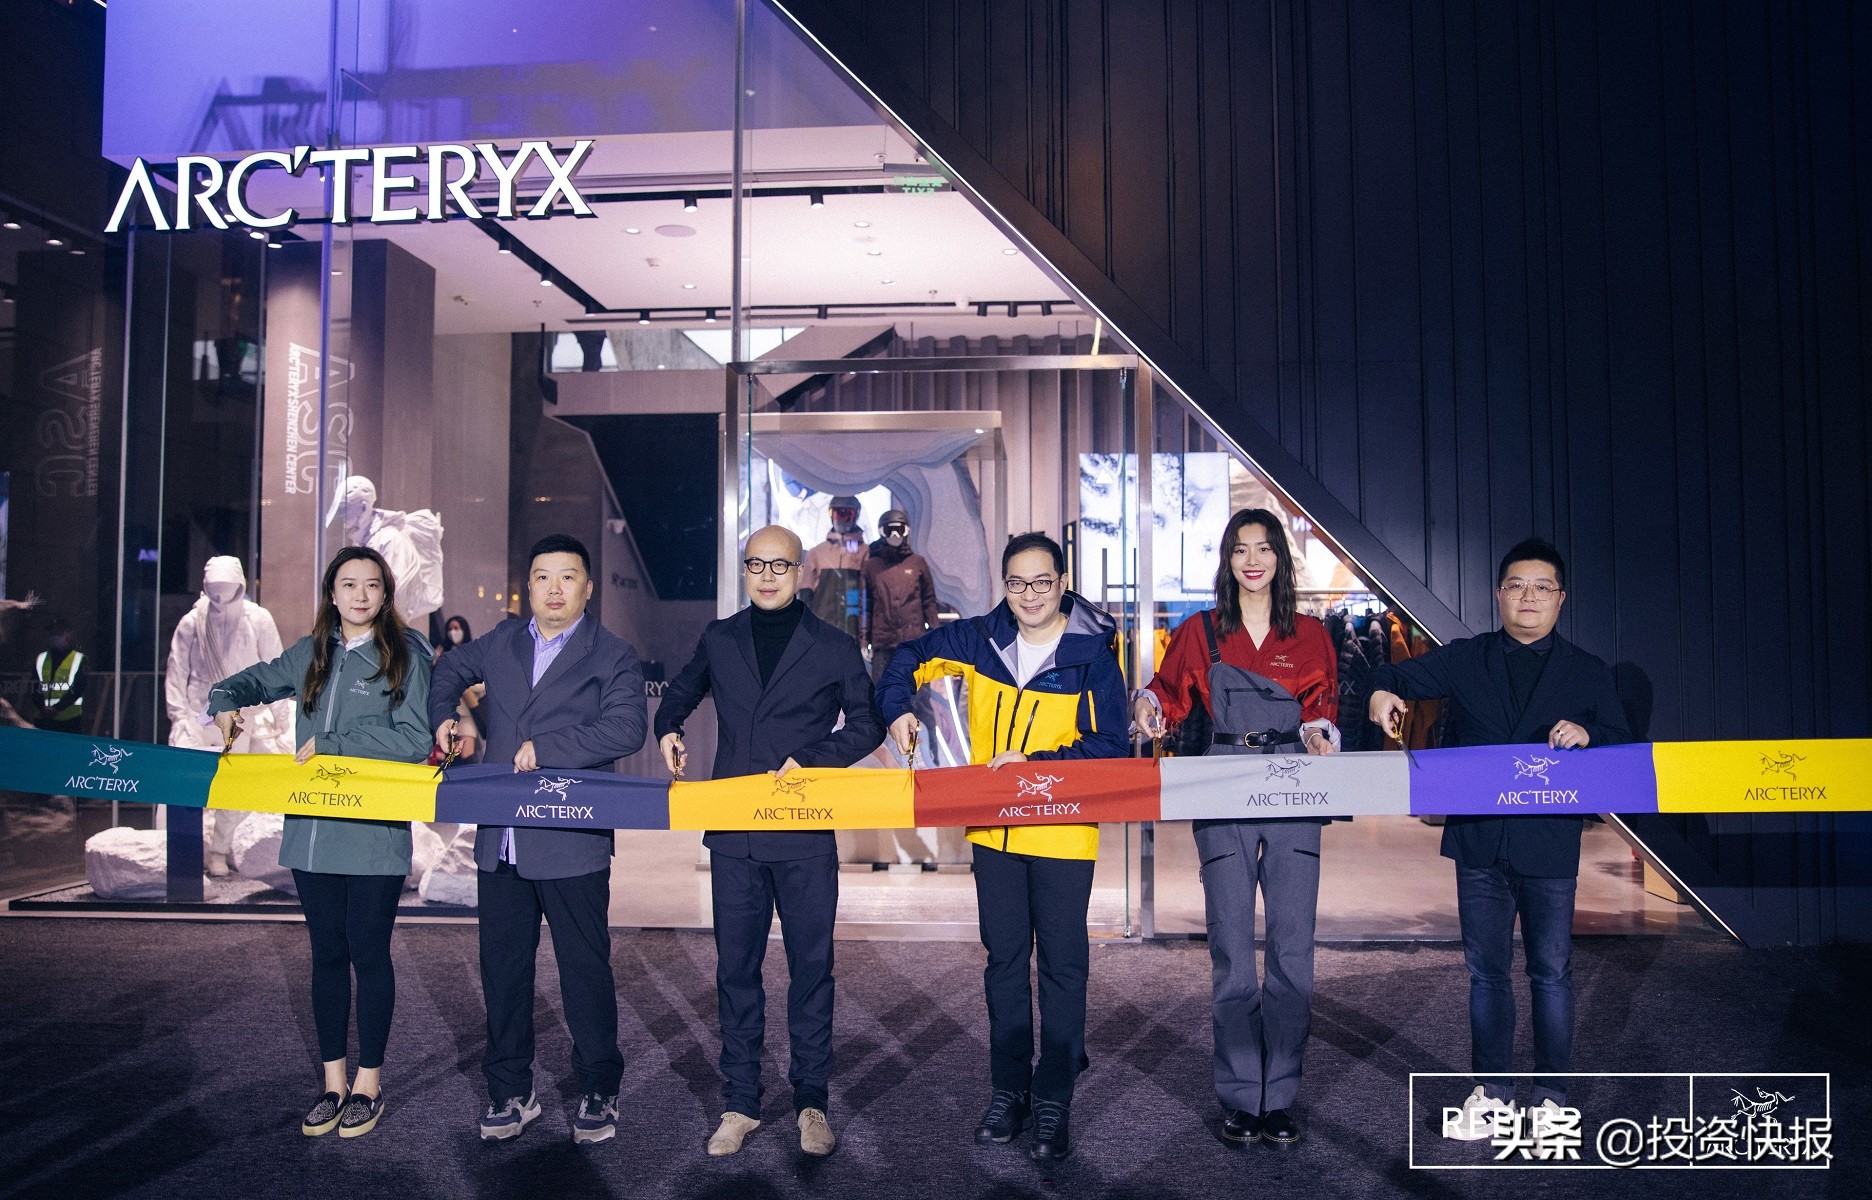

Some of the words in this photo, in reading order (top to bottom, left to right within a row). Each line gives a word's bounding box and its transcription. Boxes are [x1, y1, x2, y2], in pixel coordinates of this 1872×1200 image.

[104, 140, 596, 233] ARC'TERYX
[284, 453, 297, 494] CENTER
[65, 776, 140, 793] ARC'TERYX
[288, 791, 363, 808] ARC'TERYX
[1246, 791, 1329, 807] ARC'TERYX
[1496, 790, 1579, 805] ARC'TERYX
[1744, 786, 1827, 801] ARC'TERYX
[515, 804, 594, 820] ARC'TERYX
[753, 807, 834, 820] ARC'TERYX
[999, 802, 1081, 818] ARC'TERYX
